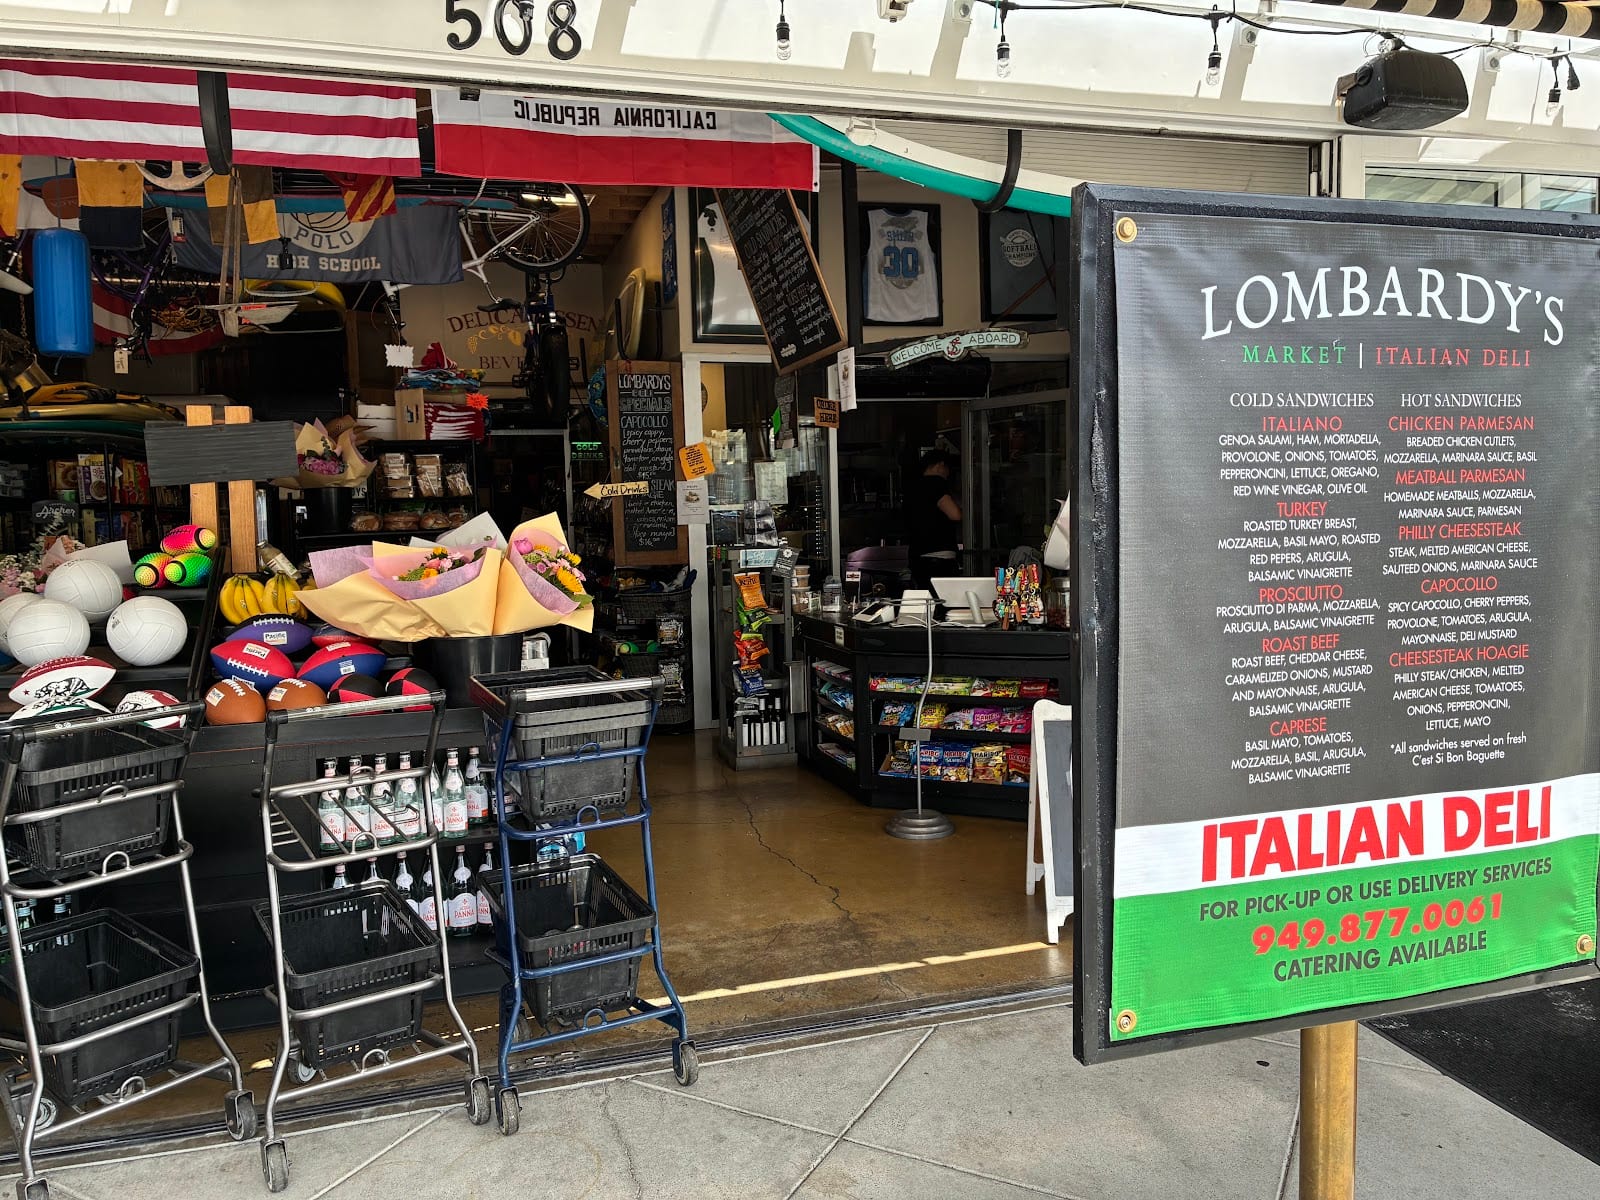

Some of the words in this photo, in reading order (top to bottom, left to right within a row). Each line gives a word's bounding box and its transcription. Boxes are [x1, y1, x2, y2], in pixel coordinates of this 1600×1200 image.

[446, 0, 582, 60] 508
[294, 226, 354, 250] POLO
[318, 256, 381, 272] SCHOOL
[883, 246, 918, 278] 30
[1201, 266, 1565, 346] LOMBARDY'S
[893, 341, 942, 363] WELCOME
[970, 333, 1016, 345] ABOARD
[1242, 344, 1347, 365] MARKET
[1376, 347, 1470, 366] ITALIAN
[1482, 349, 1531, 367] DELI
[618, 374, 670, 390] LOMBARDYS
[1230, 393, 1273, 407] COLD
[1277, 393, 1374, 407] SANDWICHES
[1401, 393, 1431, 407] HOT
[1435, 393, 1522, 408] SANDWICHES
[620, 416, 668, 428] CAPOCOLLO
[1263, 416, 1342, 432] ITALIANO
[1388, 416, 1454, 432] CHICKEN
[1460, 415, 1534, 430] PARMESAN
[1219, 435, 1256, 446] GENOA
[1258, 434, 1294, 446] SALAMI,
[1297, 434, 1321, 445] HAM,
[1324, 434, 1381, 445] MORTADELLA,
[1407, 437, 1444, 446] BREADED
[1446, 437, 1482, 446] CHICKEN
[1484, 436, 1516, 446] CUTLETS,
[1222, 451, 1282, 463] PROVOLONE,
[1285, 451, 1326, 463] ONIONS,
[1329, 450, 1378, 462] TOMATOES,
[1384, 453, 1440, 463] MOZZARELLA,
[1442, 452, 1485, 462] MARINARA
[1487, 452, 1514, 463] SAUCE,
[1517, 451, 1537, 461] BASIL
[1220, 468, 1288, 480] PEPPERONCINI,
[1291, 468, 1328, 479] LETTUCE,
[1331, 467, 1380, 478] OREGANO,
[1396, 469, 1456, 484] MEATBALL
[1460, 468, 1525, 483] PARMESAN
[600, 486, 618, 496] Cold
[620, 482, 648, 495] Drinks
[1234, 485, 1250, 496] RED
[1253, 485, 1279, 495] WINE
[1282, 484, 1325, 495] VINEGAR,
[1328, 483, 1352, 494] OLIVE
[1354, 483, 1368, 493] OIL
[1384, 491, 1434, 502] HOMEMADE
[1437, 490, 1481, 501] MEATBALLS,
[1483, 489, 1536, 500] MOZZARELLA,
[1277, 502, 1327, 517] TURKEY
[1398, 508, 1444, 519] MARINARA
[1446, 507, 1475, 518] SAUCE,
[1478, 506, 1522, 517] PARMESAN
[1244, 520, 1287, 532] ROASTED
[1289, 520, 1322, 530] TURKEY
[1325, 518, 1357, 530] BREAST,
[1399, 525, 1436, 540] PHILLY
[1439, 522, 1521, 538] CHEESESTEAK
[1218, 537, 1281, 549] MOZZARELLA,
[1284, 537, 1307, 547] BASIL
[1310, 535, 1339, 546] MAYO,
[1342, 534, 1380, 544] ROASTED
[1250, 554, 1268, 565] RED
[1271, 554, 1304, 564] PEPERS,
[1306, 552, 1351, 562] ARUGULA,
[1249, 570, 1295, 581] BALSAMIC
[1297, 567, 1352, 579] VINAIGRETTE
[1259, 584, 1343, 602] PROSCIUTTO
[1421, 576, 1498, 593] CAPOCOLLO
[1216, 604, 1274, 617] PROSCIUTTO
[1276, 604, 1285, 614] DI
[1288, 602, 1320, 614] PARMA,
[1323, 599, 1380, 611] MOZZARELLA,
[1223, 622, 1271, 633] ARUGULA,
[1274, 618, 1318, 631] BALSAMIC
[1321, 615, 1374, 627] VINAIGRETTE
[1388, 616, 1439, 630] PROVOLONE,
[1442, 614, 1487, 625] TOMATOES,
[1489, 612, 1531, 623] ARUGULA,
[1262, 636, 1307, 653] ROAST
[1311, 634, 1340, 650] BEEF
[1232, 657, 1262, 668] ROAST
[1265, 655, 1286, 666] BEEF,
[1289, 652, 1331, 664] CHEDDAR
[1333, 649, 1367, 661] CHEESE,
[1389, 648, 1473, 667] CHEESESTEAK
[1477, 644, 1529, 660] HOAGIE
[1225, 671, 1287, 686] CARAMELIZED
[1290, 668, 1330, 680] ONIONS,
[1332, 664, 1372, 676] MUSTARD
[1394, 672, 1419, 683] PHILLY
[1421, 667, 1490, 681] STEAK/CHICKEN,
[1492, 665, 1524, 676] MELTED
[1232, 690, 1254, 702] AND
[1257, 685, 1320, 699] MAYONNAISE,
[1322, 681, 1366, 694] ARUGULA,
[1393, 687, 1438, 701] AMERICAN
[1440, 684, 1473, 696] CHEESE,
[1475, 681, 1525, 694] TOMATOES,
[1407, 704, 1445, 716] ONIONS,
[1447, 699, 1510, 713] PEPPERONCINI,
[1269, 717, 1327, 737] CAPRESE
[1426, 718, 1461, 731] LETTUCE,
[1463, 716, 1491, 727] MAYO
[1245, 740, 1269, 752] BASIL
[1272, 737, 1301, 749] MAYO,
[1303, 732, 1353, 746] TOMATOES,
[1409, 737, 1458, 753] sandwiches
[1460, 734, 1490, 748] served
[1493, 736, 1504, 746] on
[1506, 731, 1527, 744] fresh
[1231, 754, 1292, 769] MOZZARELLA,
[1295, 751, 1320, 763] BASIL,
[1323, 746, 1366, 760] ARUGULA,
[1412, 754, 1433, 766] C'est
[1435, 752, 1444, 764] Si
[1447, 751, 1464, 762] Bon
[1466, 750, 1505, 763] Baguette
[1202, 800, 1424, 882] ITALIAN
[1443, 786, 1552, 852] DELI
[1200, 901, 1239, 921] FOR
[1245, 888, 1321, 915] PICK-UP
[1326, 886, 1353, 905] OR
[1359, 879, 1392, 900] USE
[1399, 868, 1477, 896] DELIVERY
[1482, 857, 1552, 885] SERVICES
[454, 909, 474, 918] PANNA
[1251, 893, 1504, 956] 949.877.0061
[1273, 948, 1380, 982] CATERING
[1388, 930, 1488, 967] AVAILABLE
